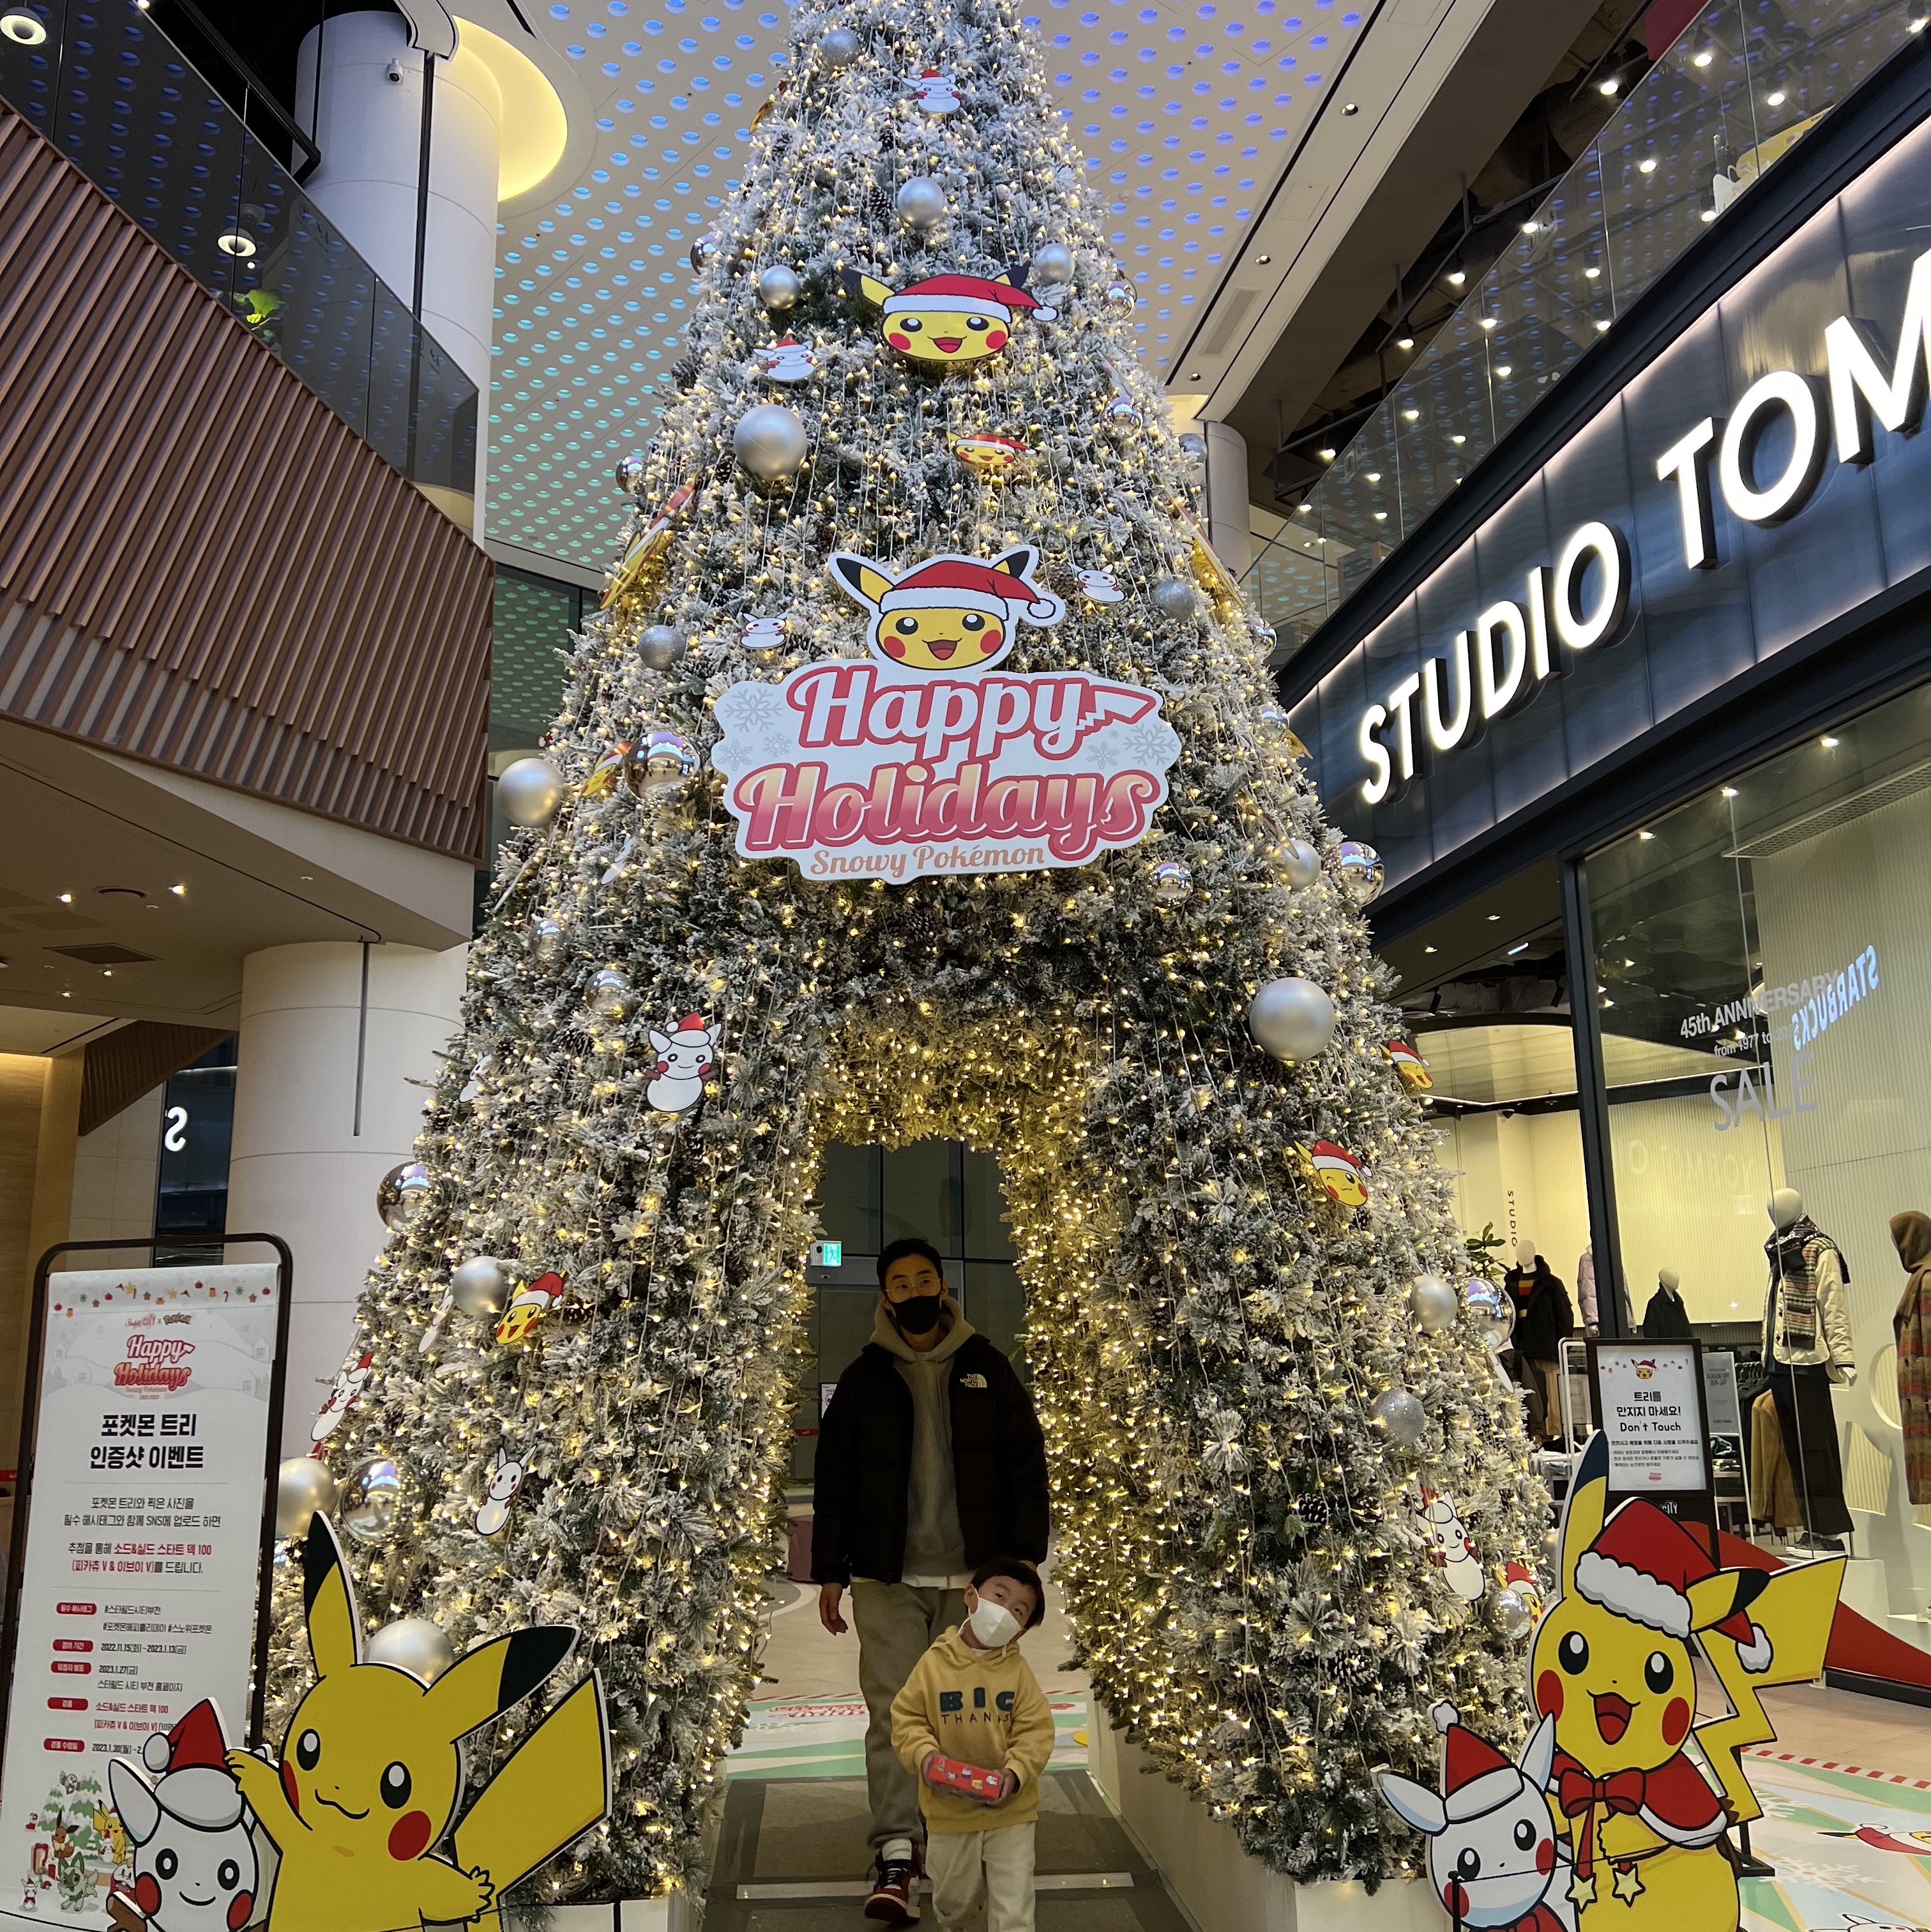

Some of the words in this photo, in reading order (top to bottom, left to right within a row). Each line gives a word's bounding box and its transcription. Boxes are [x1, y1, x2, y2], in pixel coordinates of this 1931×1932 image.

[1360, 521, 1622, 805] STUDIO
[1657, 248, 1931, 570] TOM
[787, 665, 1156, 762] Happy
[732, 761, 1160, 861] Holidays
[810, 849, 907, 878] Snowy
[912, 845, 1045, 872] Pokémon
[1680, 1012, 1711, 1038] 45th
[1714, 969, 1839, 1028] ANNIVERSARY
[1714, 1044, 1736, 1058] from
[1762, 1031, 1771, 1045] to
[1710, 1051, 1820, 1132] SALE
[1508, 1190, 1517, 1247] STUDIO
[126, 1335, 195, 1364] Happy
[114, 1362, 192, 1391] Holidays
[1616, 1406, 1646, 1417] 만지지
[1649, 1406, 1681, 1417] 마세요!
[101, 1413, 155, 1436] 포켓몬
[160, 1413, 197, 1436] 트리
[1620, 1421, 1648, 1432] Don't
[1651, 1422, 1681, 1431] Touch
[90, 1446, 145, 1469] 인증샷
[149, 1446, 204, 1469] 이벤트
[91, 1497, 116, 1509] 포켓몬
[118, 1497, 145, 1509] 트리와
[148, 1498, 165, 1509] 찍은
[167, 1498, 194, 1509] 사진을
[64, 1514, 80, 1526] 필수
[82, 1514, 125, 1526] 해시태그와
[127, 1515, 144, 1526] 함께
[146, 1515, 170, 1526] SNS에
[174, 1516, 201, 1527] 업로드
[203, 1516, 221, 1527] 하면
[68, 1542, 93, 1554] 추첨을
[95, 1542, 112, 1554] 통해
[114, 1543, 155, 1555] 소드&실드
[157, 1544, 184, 1555] 스타트
[198, 1544, 212, 1555] 100
[102, 1561, 108, 1571] V
[109, 1561, 115, 1571] &
[117, 1561, 143, 1572] 이브이
[165, 1562, 204, 1574] 드립니다.
[98, 1680, 124, 1690] 스타필드
[125, 1680, 139, 1691] 시티
[140, 1681, 154, 1691] 부천
[96, 1701, 126, 1712] 소드&실드
[127, 1703, 148, 1713] 스타트
[158, 1703, 169, 1714] 100
[129, 1721, 149, 1731] 이브이
